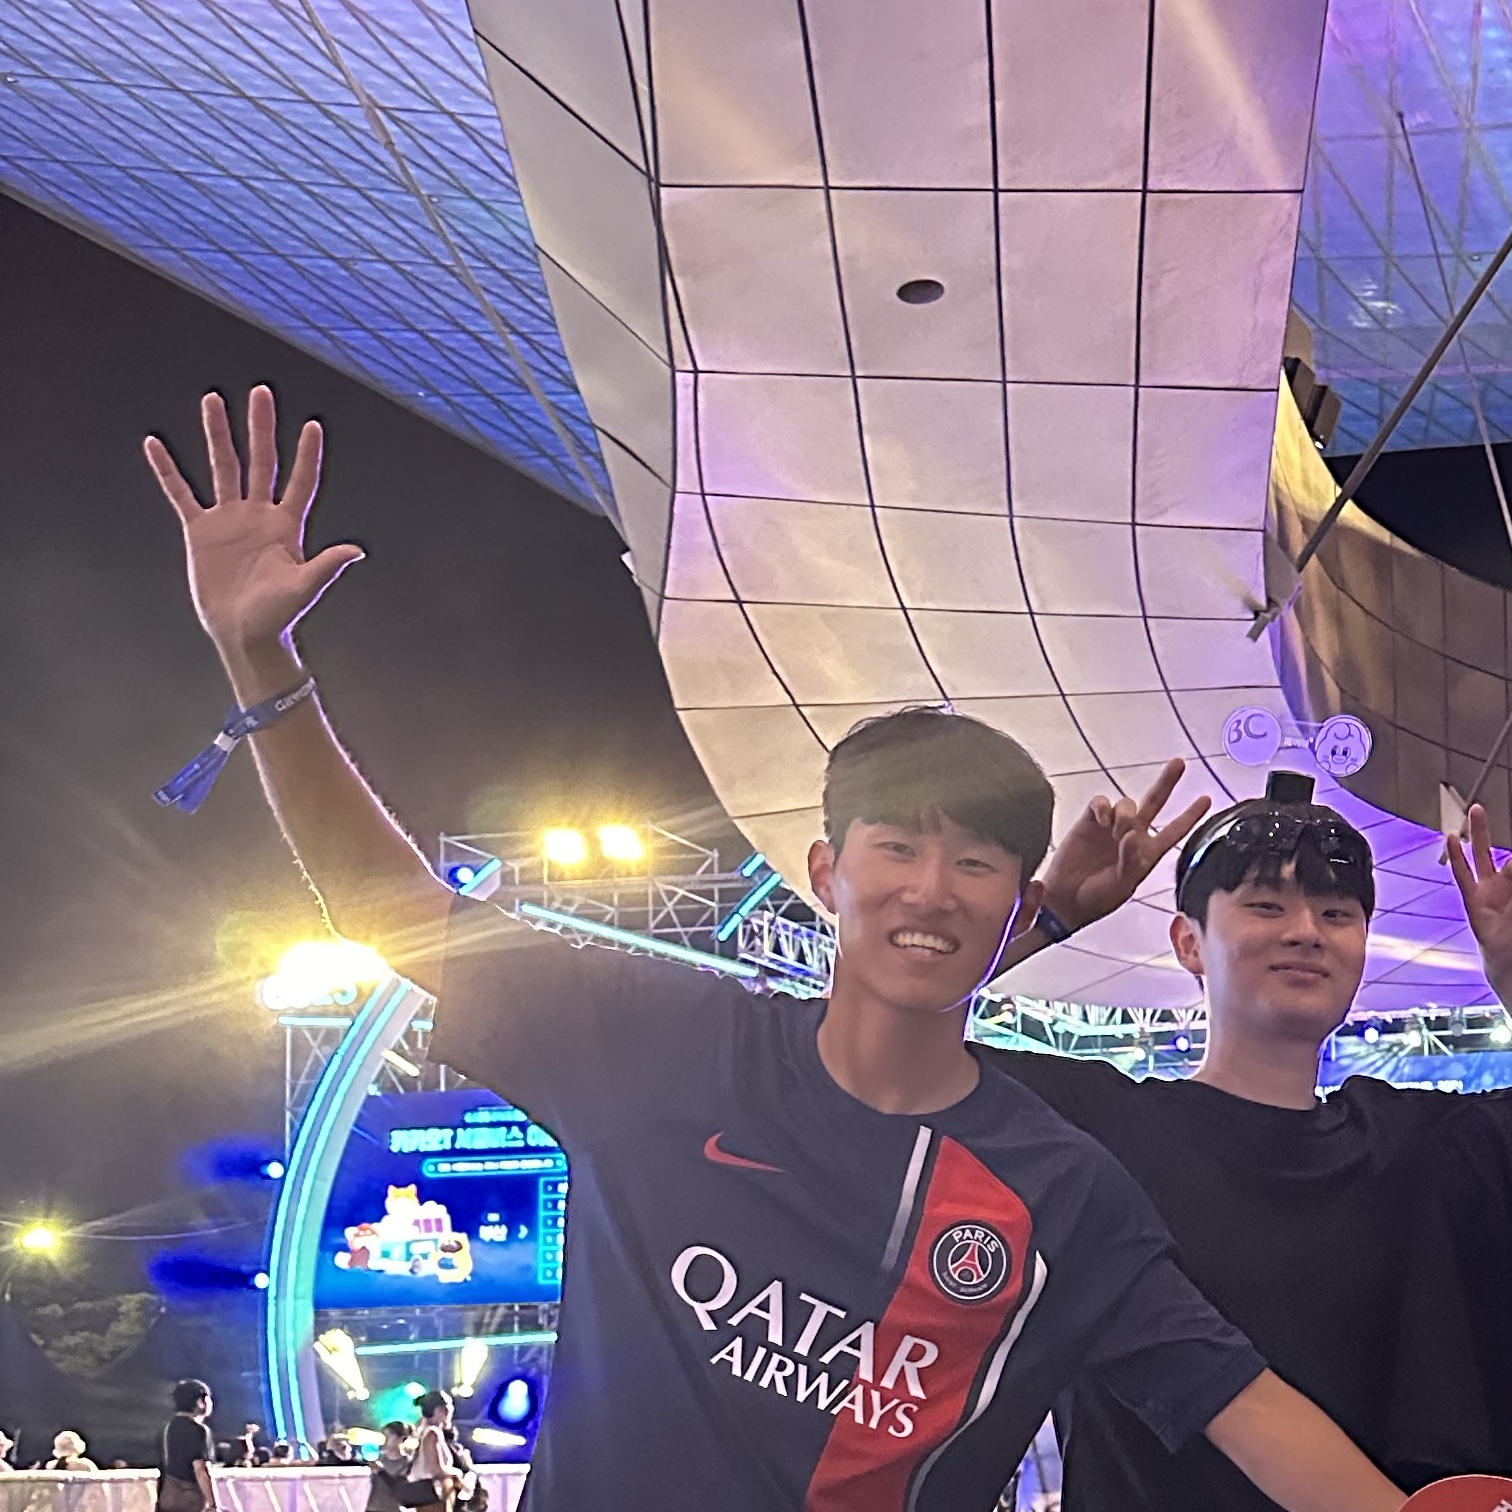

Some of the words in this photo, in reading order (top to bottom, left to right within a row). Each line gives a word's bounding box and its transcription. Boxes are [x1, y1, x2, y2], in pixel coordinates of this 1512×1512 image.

[952, 1228, 1000, 1253] PARIS
[670, 1245, 940, 1400] QATAR
[709, 1336, 920, 1439] AIRWAYS
